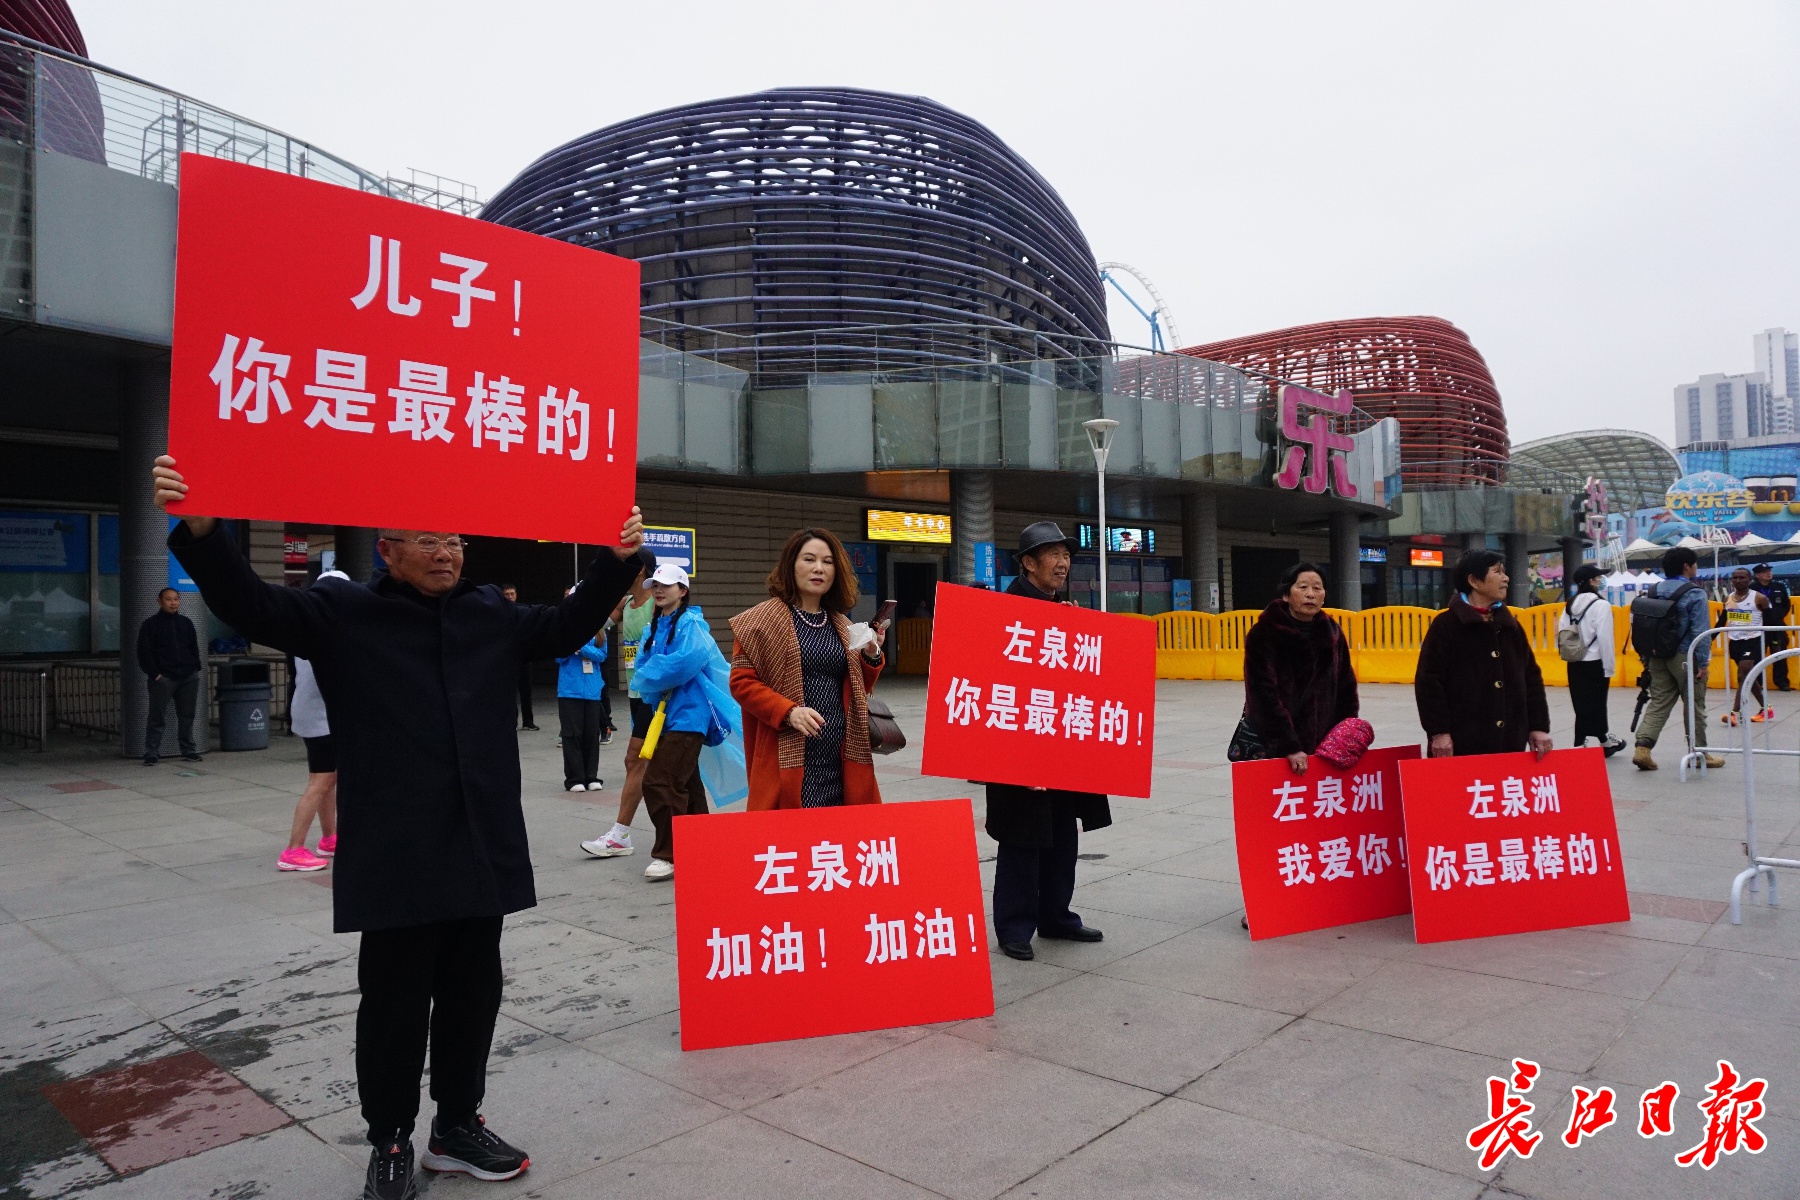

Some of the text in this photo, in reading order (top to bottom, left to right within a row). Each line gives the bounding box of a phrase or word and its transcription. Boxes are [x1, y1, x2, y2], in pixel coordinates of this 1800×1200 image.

[351, 235, 521, 337] 儿子！
[210, 334, 615, 463] 你是最棒的！
[1274, 385, 1357, 498] 乐
[1663, 489, 1756, 510] 欢乐谷
[985, 544, 993, 577] 洗手间
[1003, 621, 1102, 676] 左泉洲
[945, 677, 1144, 746] 你是最棒的！
[1273, 771, 1384, 822] 左泉洲
[1467, 773, 1561, 818] 左泉洲
[755, 837, 900, 894] 左泉洲
[1277, 834, 1407, 887] 我爱你！
[1426, 832, 1613, 891] 你是最棒的！
[706, 907, 977, 980] 加油！ 加油！
